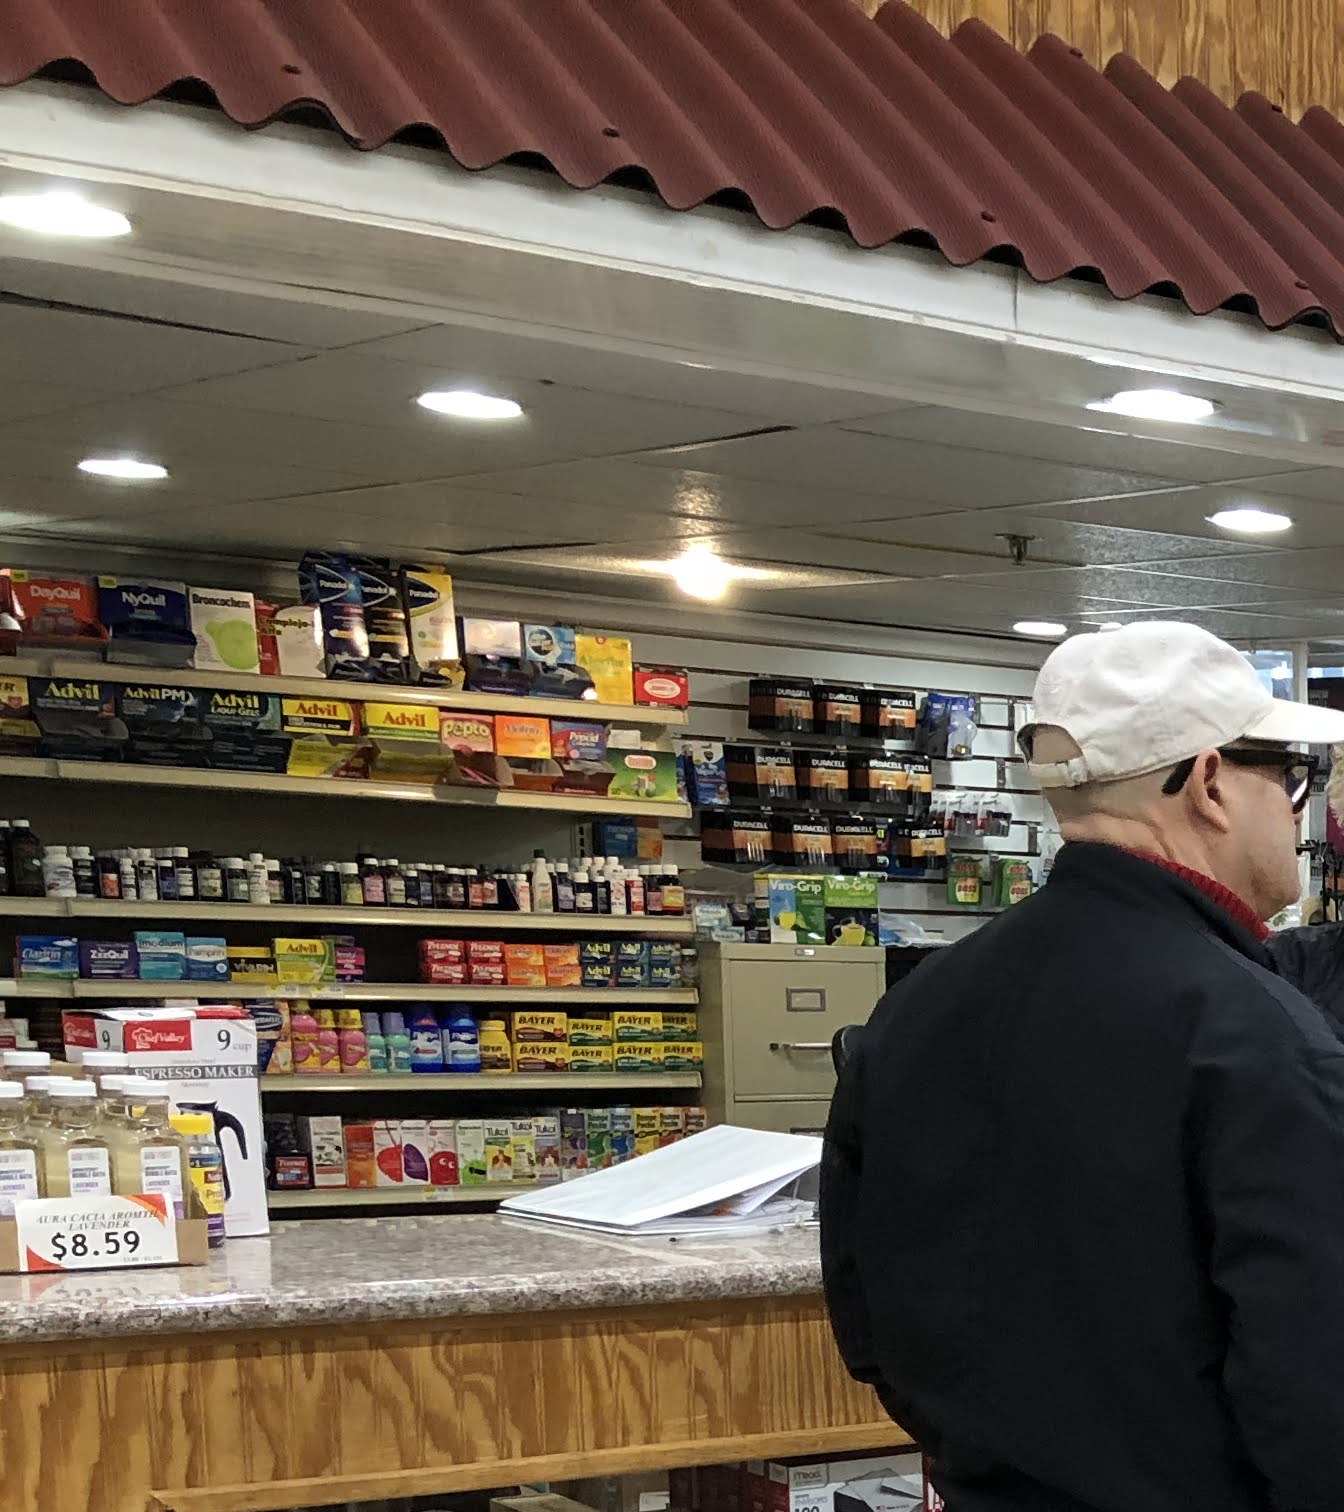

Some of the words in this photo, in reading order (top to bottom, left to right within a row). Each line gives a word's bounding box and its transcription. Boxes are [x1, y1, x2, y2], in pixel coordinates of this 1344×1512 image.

[319, 578, 350, 591] Panadol
[30, 584, 81, 601] DayQuil
[408, 587, 438, 600] Panadol
[121, 591, 167, 608] NyQuil
[191, 593, 251, 609] Broncochem
[45, 682, 99, 701] Advil
[123, 686, 161, 701] Advil
[161, 688, 186, 702] PM
[210, 691, 259, 709] Advil
[295, 701, 338, 718] Advil
[383, 711, 427, 728] Advil
[443, 720, 490, 741] pepto
[811, 758, 846, 768] DURACELL
[793, 824, 829, 834] DURACELL
[769, 881, 822, 896] Viro-Grip
[827, 880, 876, 894] Viro-Grip
[285, 942, 318, 955] Advil
[586, 943, 611, 954] Advil
[586, 966, 611, 976] Advil
[517, 1015, 555, 1026] BAYER
[617, 1015, 653, 1026] BAYER
[571, 1022, 604, 1033] BAYER
[102, 1028, 112, 1047] 9
[216, 1029, 232, 1051] 9
[519, 1045, 558, 1056] BAYER
[570, 1048, 603, 1058] BAYER
[616, 1045, 653, 1056] BAYER
[663, 1045, 695, 1055] BAYER
[135, 1066, 202, 1082] ESPRESSO
[204, 1065, 255, 1079] MAKER
[486, 1127, 509, 1138] Tukol
[534, 1124, 557, 1135] Tukol
[67, 1220, 131, 1232] LAVENDER
[51, 1230, 141, 1261] $8.59
